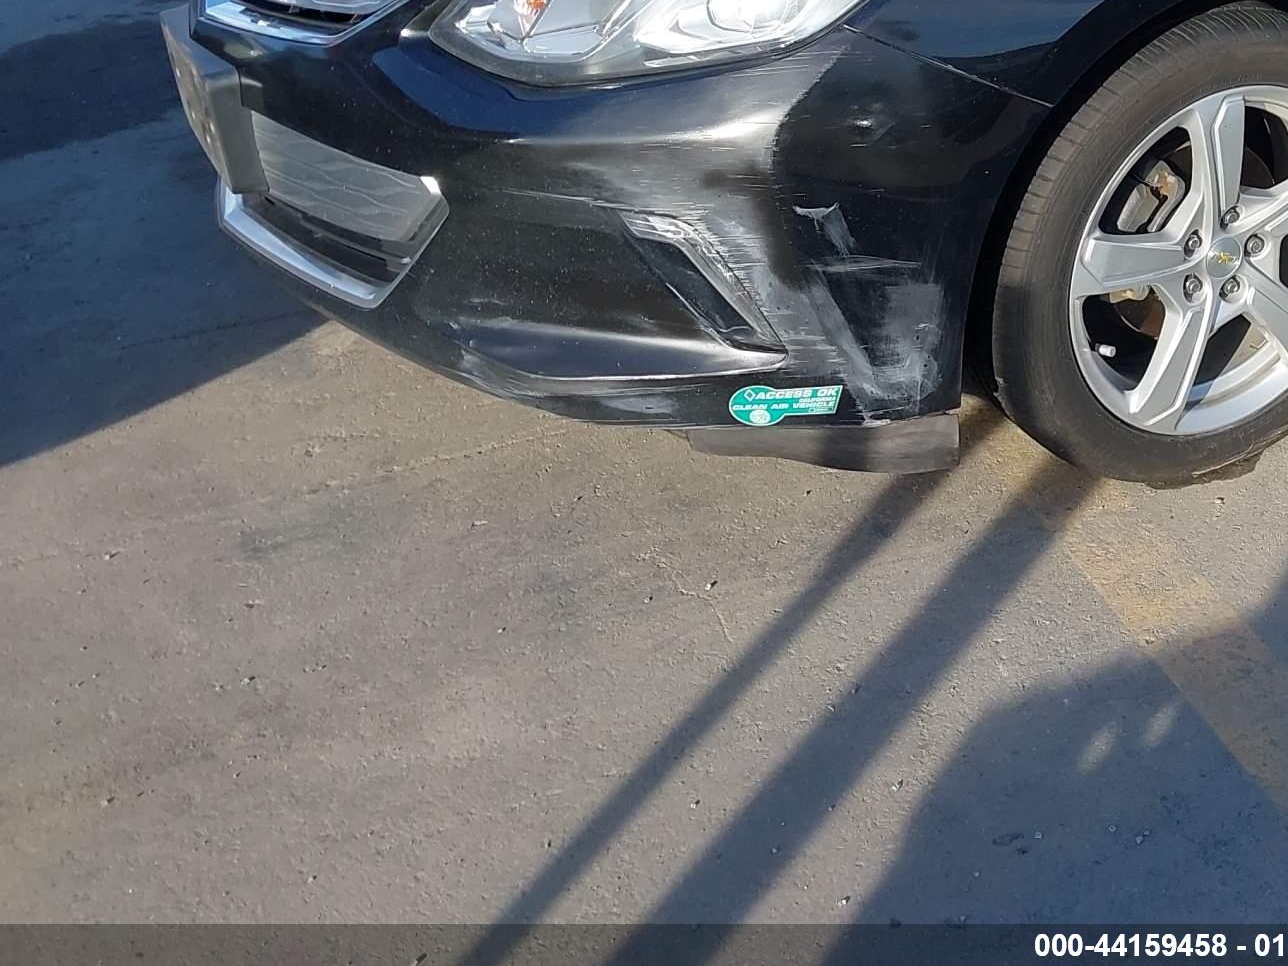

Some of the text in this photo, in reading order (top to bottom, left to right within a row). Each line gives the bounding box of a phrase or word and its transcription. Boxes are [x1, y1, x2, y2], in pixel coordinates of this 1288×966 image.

[755, 387, 839, 400] ACCESS OK
[732, 400, 835, 411] CLEAN AIR VEHICLE
